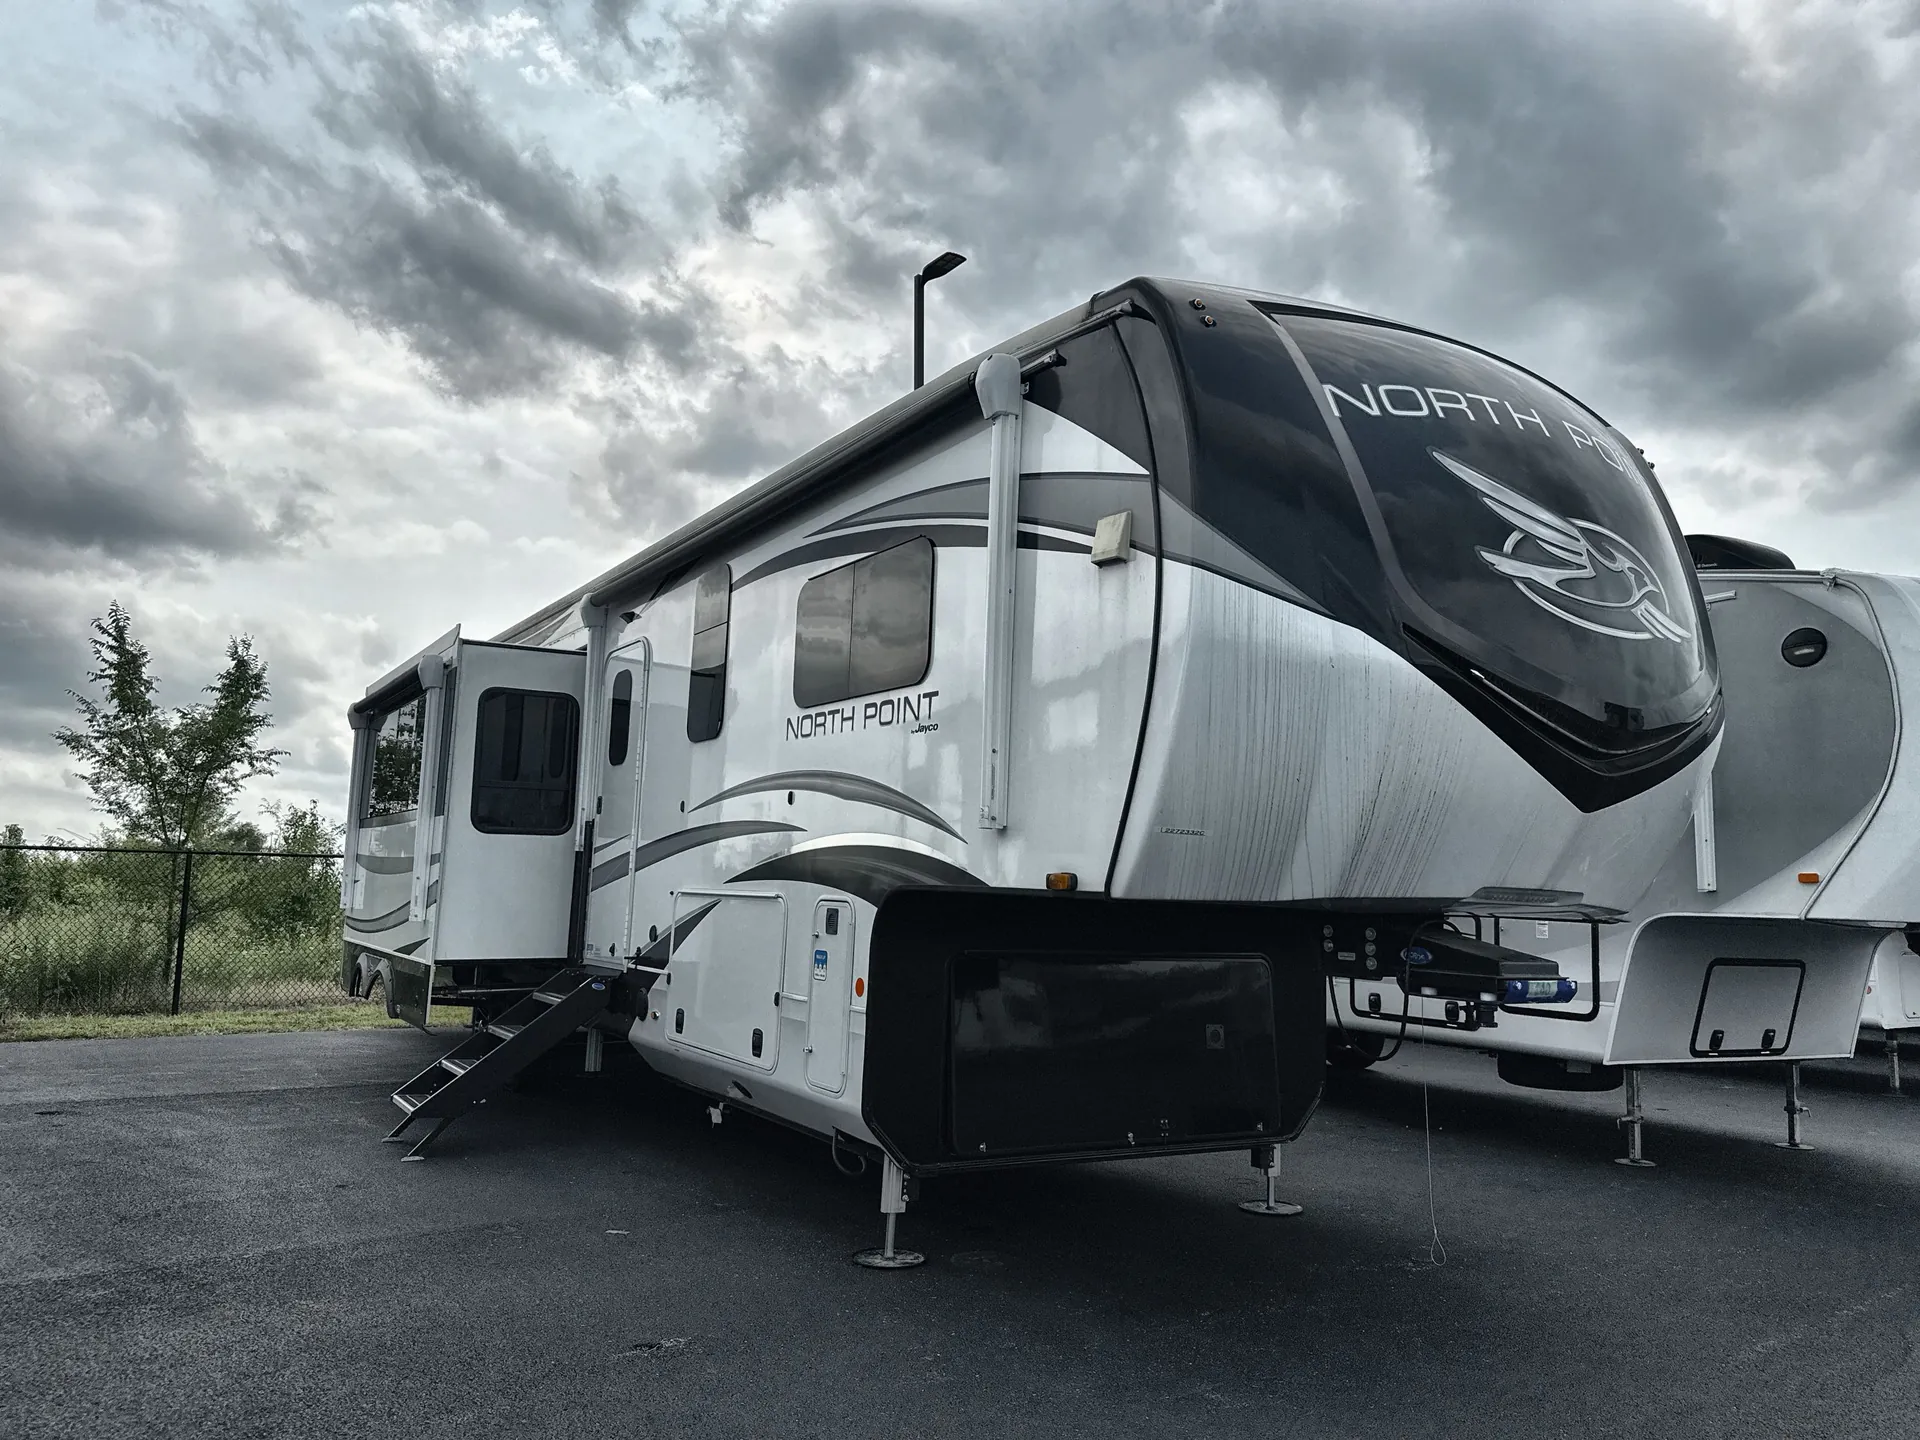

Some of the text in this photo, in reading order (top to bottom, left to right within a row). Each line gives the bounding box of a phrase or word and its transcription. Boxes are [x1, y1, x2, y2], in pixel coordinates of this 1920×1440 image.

[1322, 383, 1550, 437] NORTH
[786, 690, 939, 741] NORTH POINT
[915, 722, 939, 735] Jayco
